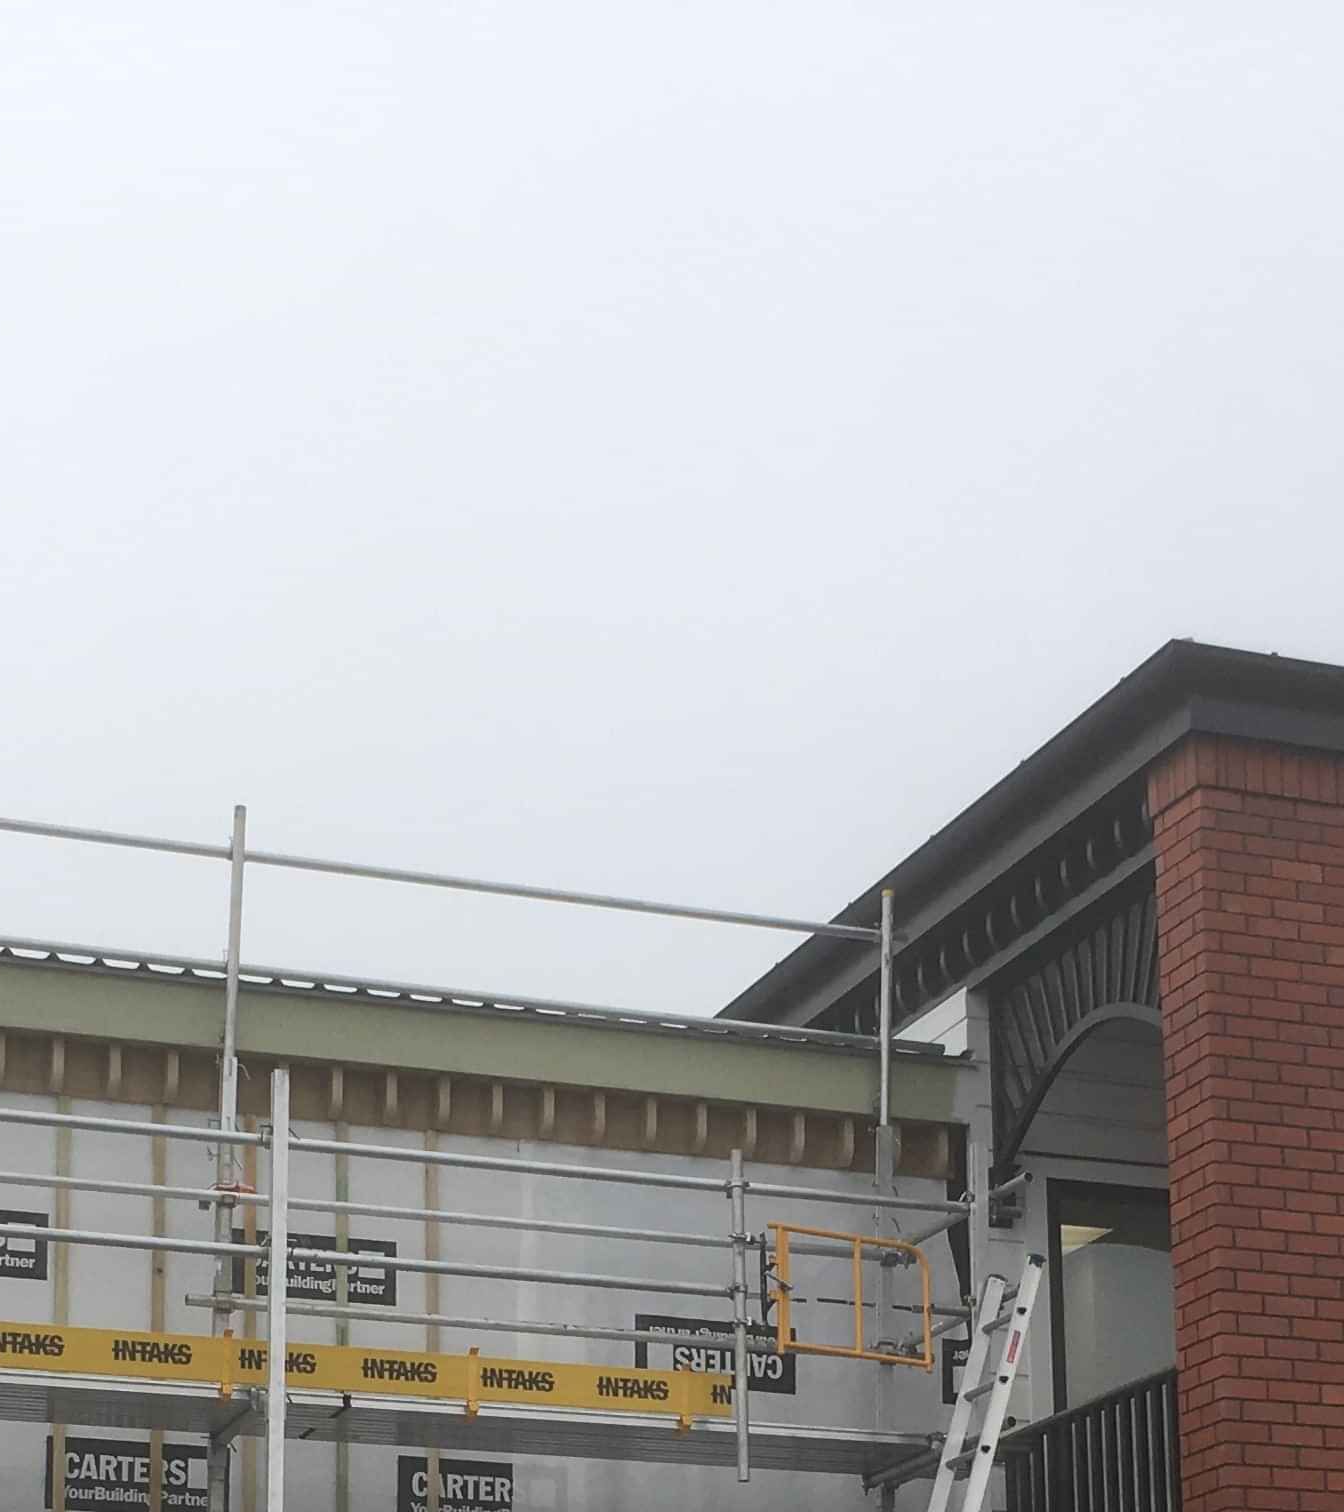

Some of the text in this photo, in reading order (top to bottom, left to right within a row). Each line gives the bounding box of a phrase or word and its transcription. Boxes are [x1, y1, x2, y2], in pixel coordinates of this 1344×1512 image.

[112, 1340, 193, 1366] INTAKS
[239, 1348, 317, 1375] INKS
[362, 1357, 438, 1384] INTAKS
[481, 1367, 555, 1393] INTAKS
[597, 1376, 669, 1402] INTAKS
[675, 1345, 783, 1380] CATERS
